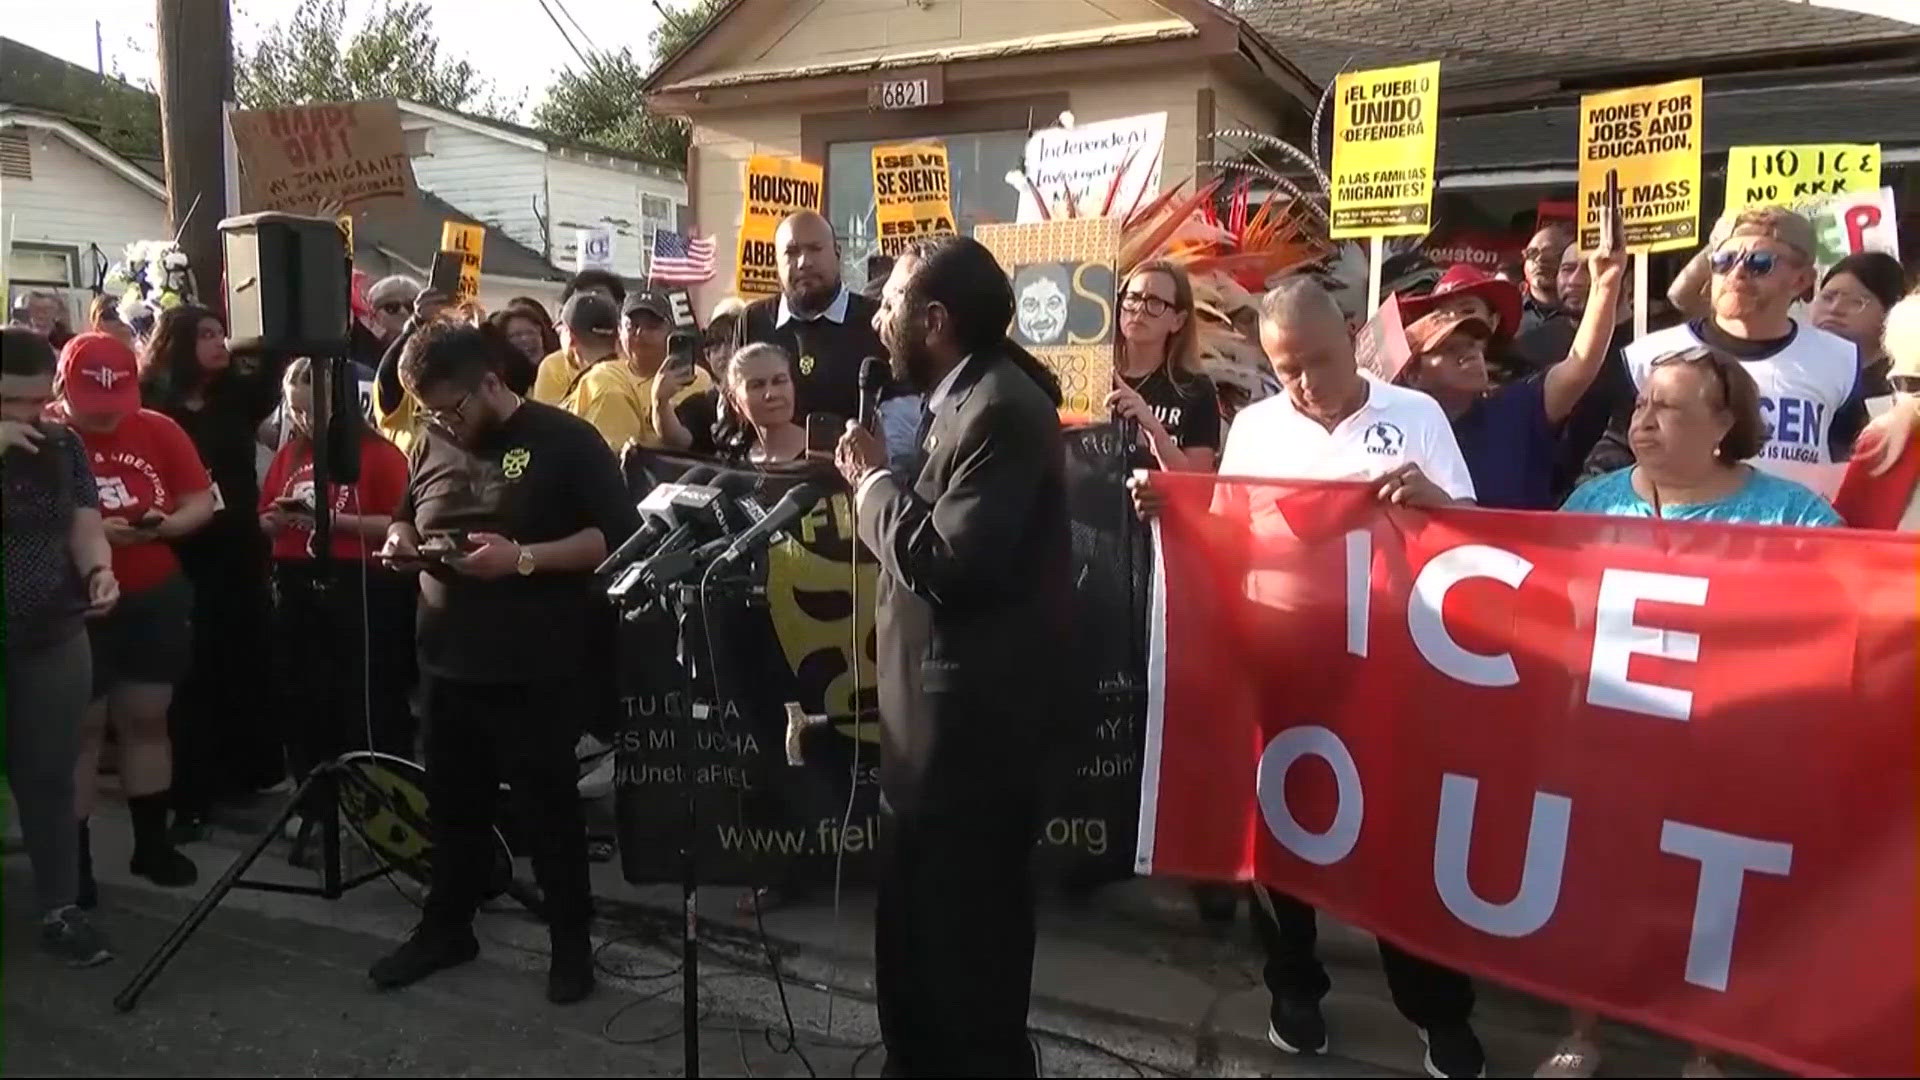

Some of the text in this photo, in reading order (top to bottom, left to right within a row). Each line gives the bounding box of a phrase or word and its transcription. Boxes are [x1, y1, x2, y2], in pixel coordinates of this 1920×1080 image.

[883, 80, 928, 106] 6821
[1372, 77, 1429, 98] PUEBLO
[1351, 98, 1421, 126] UNIDO
[1589, 95, 1692, 124] MONEY FOR
[1588, 114, 1692, 143] JOBS AND
[917, 153, 944, 167] VE
[1588, 134, 1692, 161] EDUCATION,
[1338, 168, 1426, 185] A LAS FAMILIAS
[1751, 150, 1873, 178] NO ICE
[749, 174, 819, 208] HOUSTON
[877, 168, 947, 195] SE SIENTE
[1338, 182, 1424, 202] MIGRANTES!
[1632, 179, 1690, 203] MASS
[1747, 184, 1777, 202] NO
[882, 217, 952, 235] ESTA
[742, 239, 776, 267] ABB
[1427, 246, 1499, 264] ouston
[1043, 354, 1087, 373] NZO
[1758, 396, 1825, 447] CEN
[1768, 446, 1778, 459] IS
[1781, 447, 1819, 464] ILLEGAL
[1345, 529, 1709, 721] ICE
[621, 695, 656, 717] TU
[650, 729, 675, 749] MI
[696, 731, 760, 756] UCHA
[615, 762, 752, 790] #UnetaFIEL
[717, 815, 881, 856] www.fiel
[1258, 724, 1795, 992] OUT
